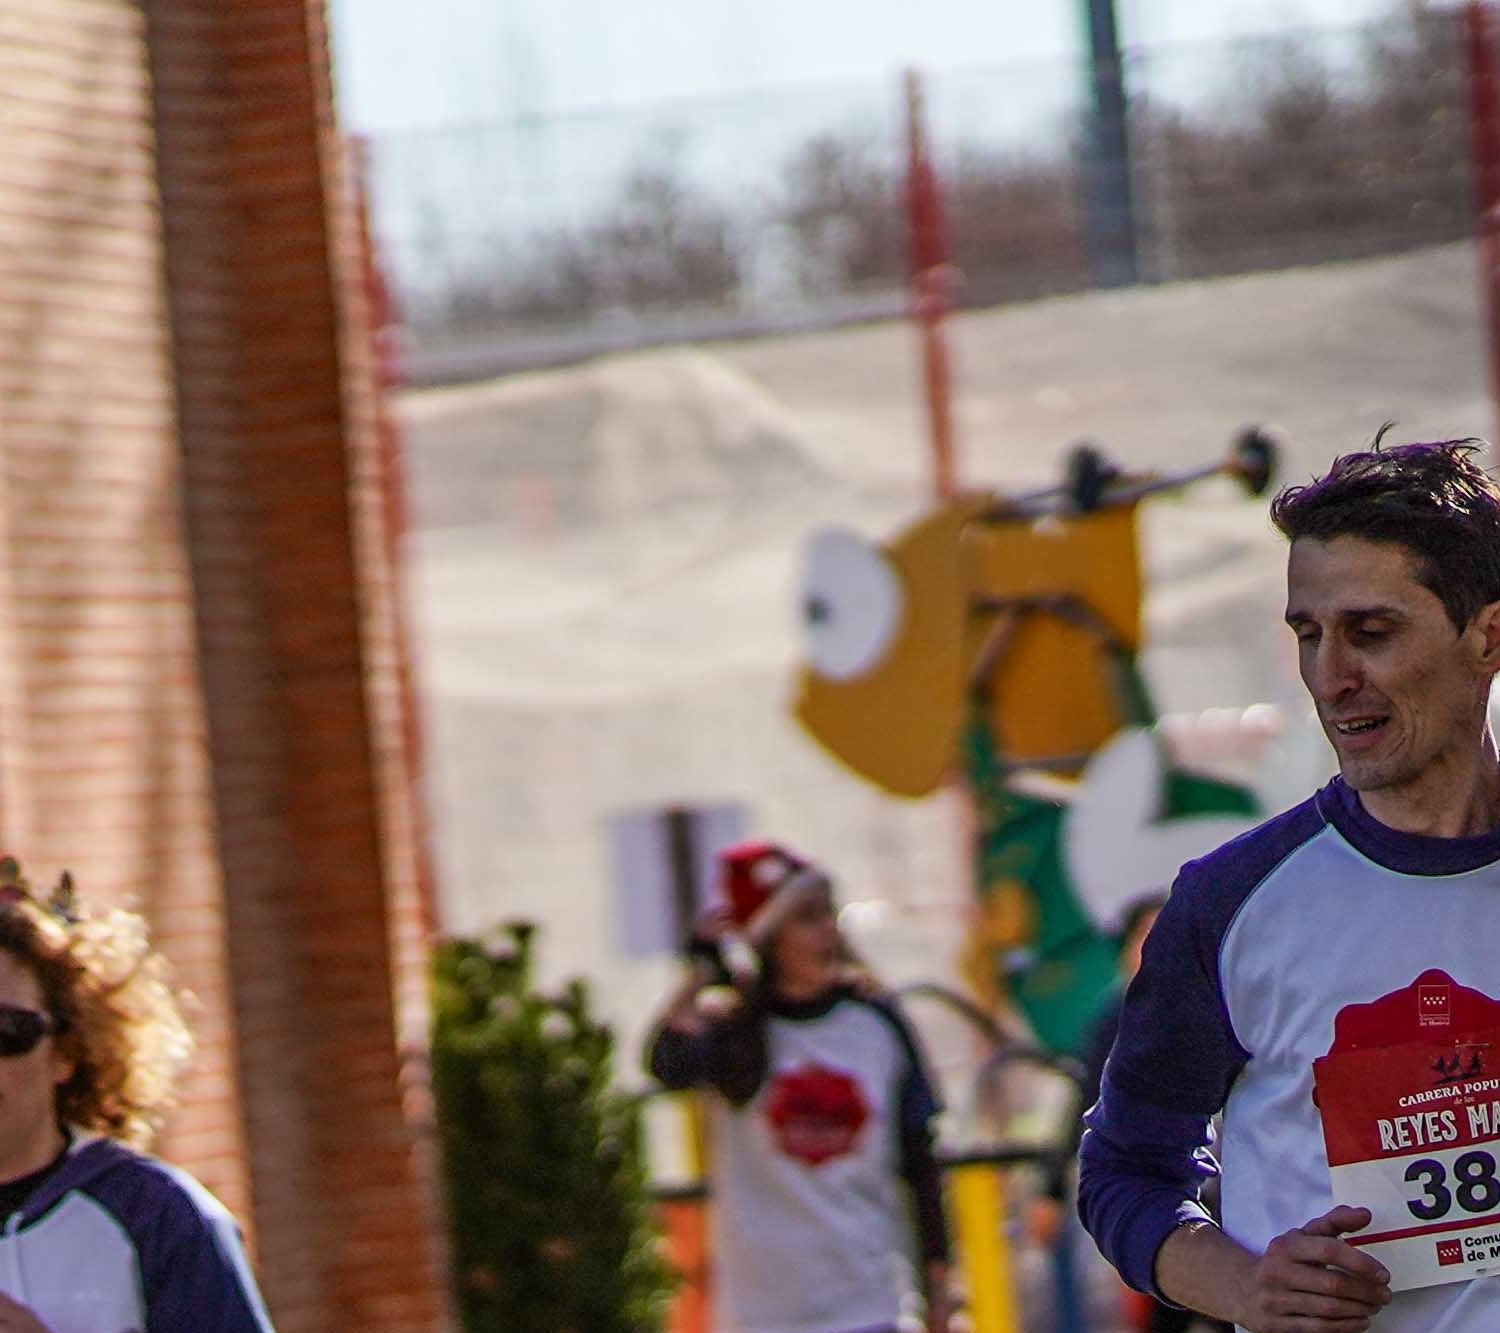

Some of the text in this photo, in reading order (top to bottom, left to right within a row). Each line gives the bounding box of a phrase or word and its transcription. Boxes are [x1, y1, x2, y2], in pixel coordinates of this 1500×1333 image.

[1398, 1085, 1462, 1108] CARRERA
[1379, 1110, 1458, 1152] REYES
[1467, 1248, 1486, 1262] de
